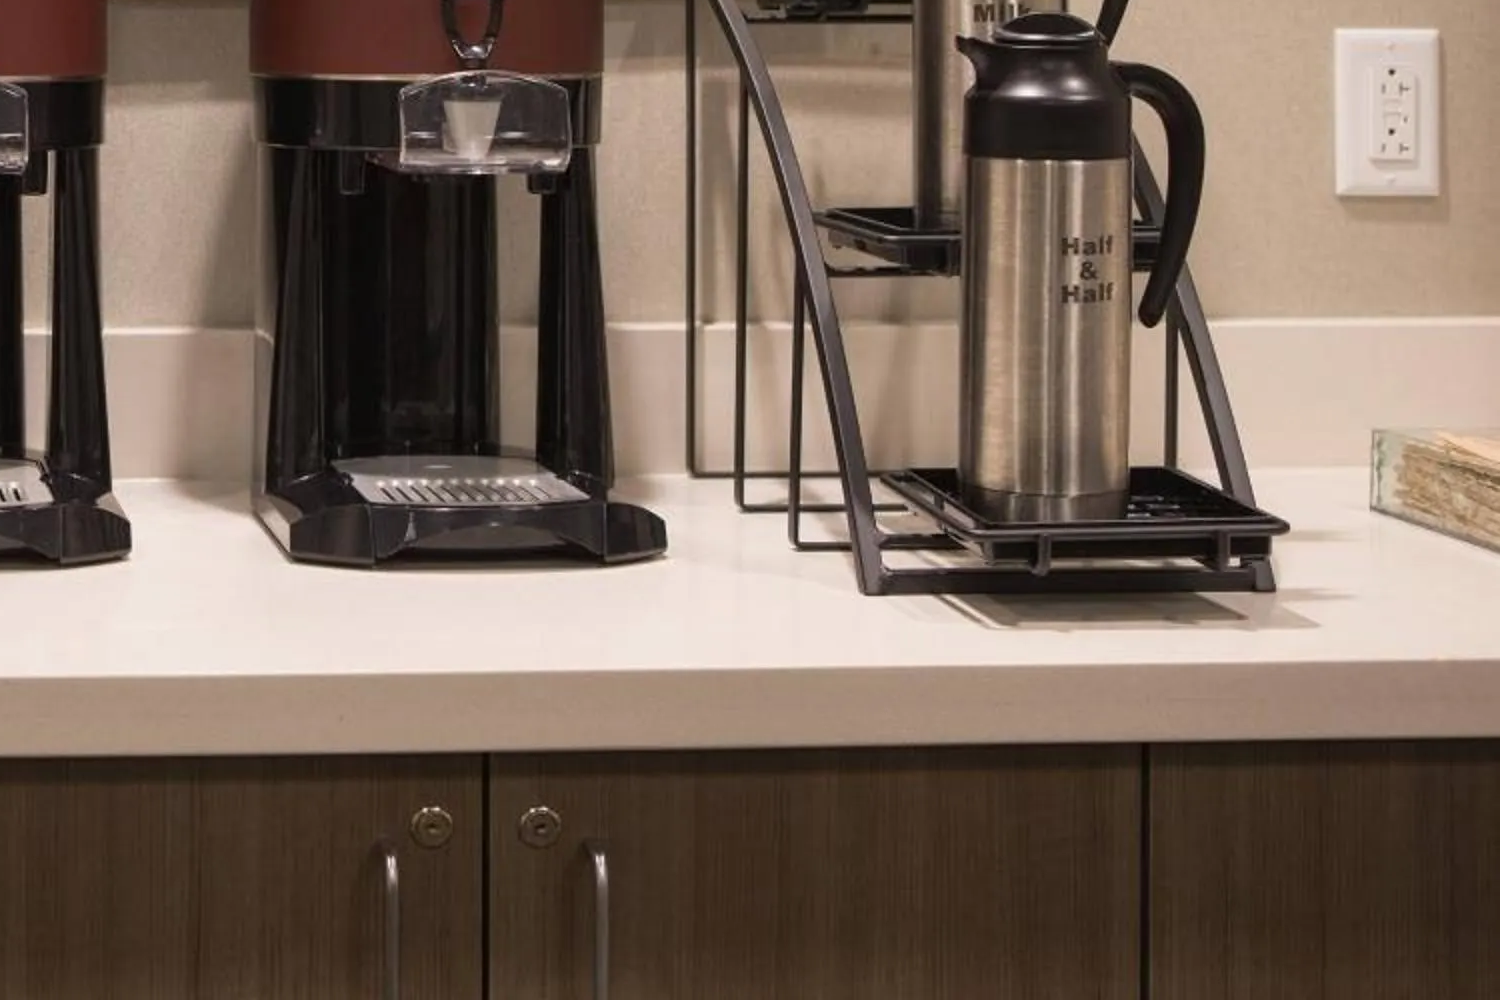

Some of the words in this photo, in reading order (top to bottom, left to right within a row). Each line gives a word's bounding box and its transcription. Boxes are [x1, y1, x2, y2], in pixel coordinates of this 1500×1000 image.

[1061, 235, 1113, 256] Half
[1080, 261, 1099, 280] &
[1061, 283, 1113, 304] Half
